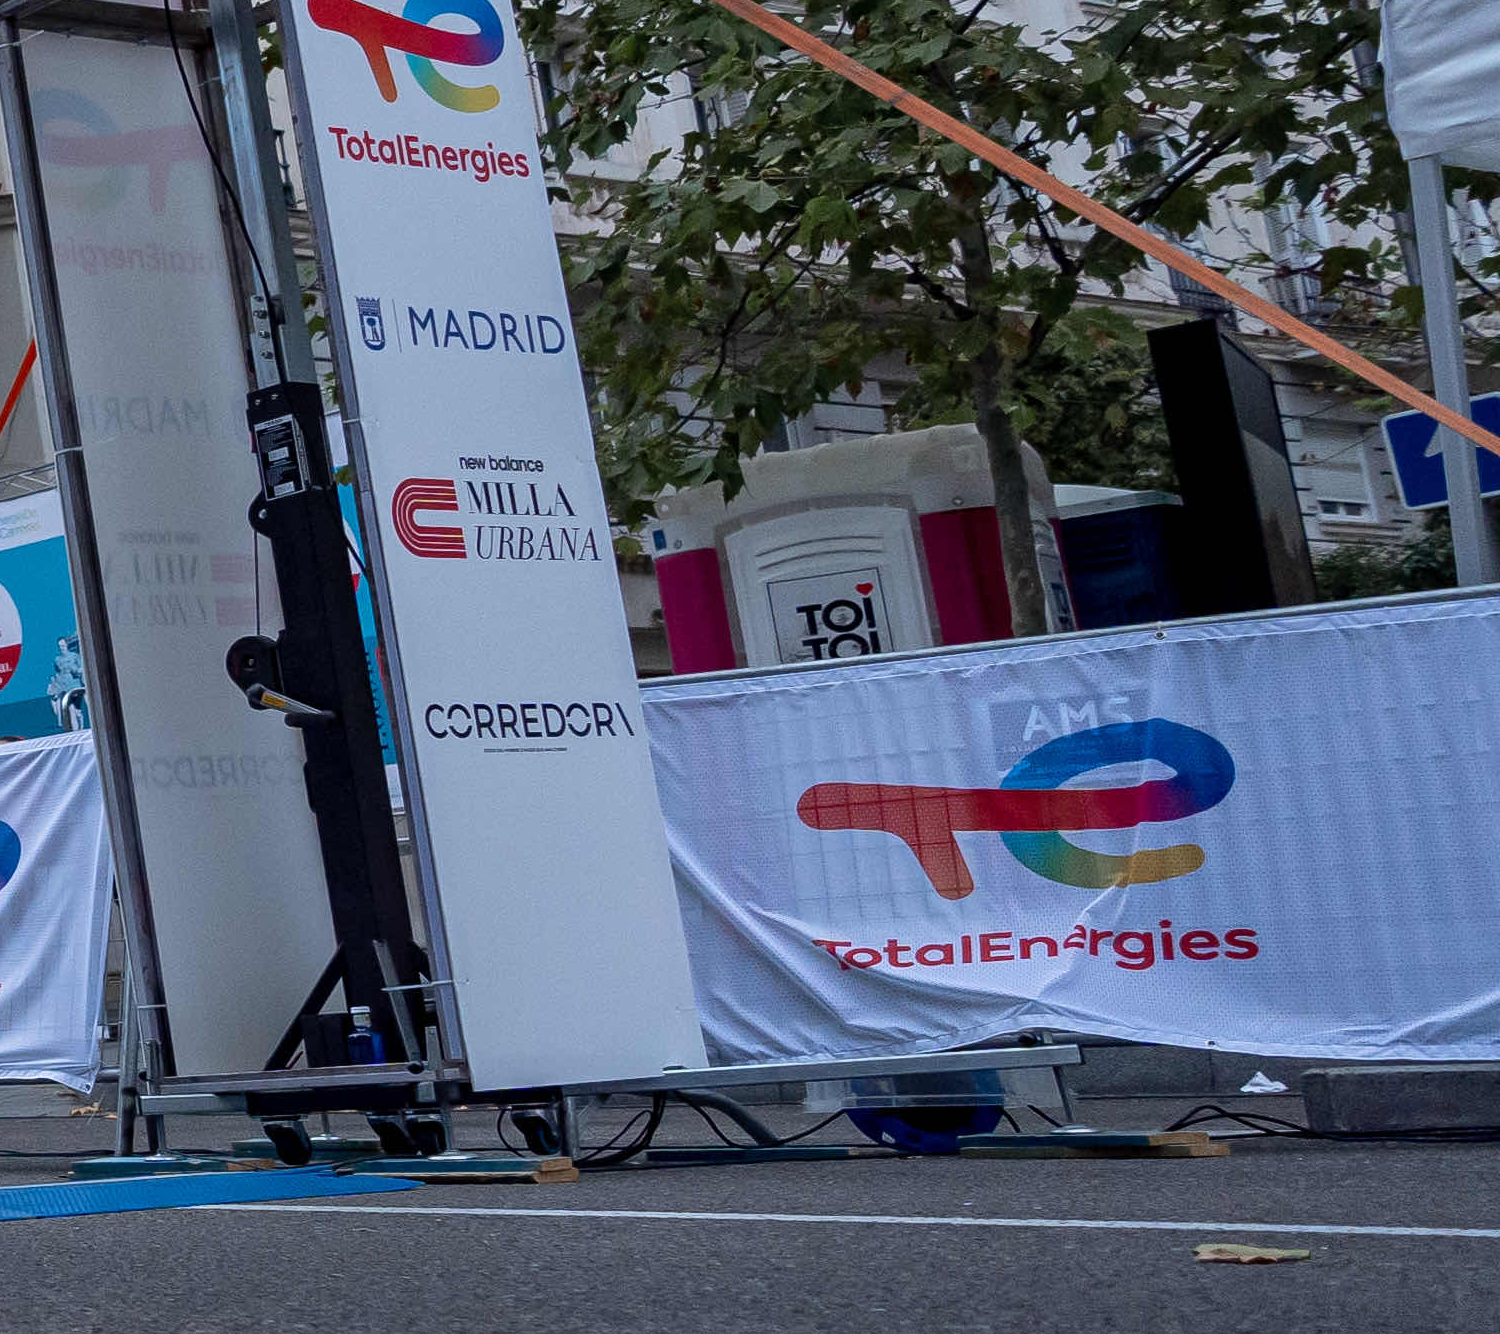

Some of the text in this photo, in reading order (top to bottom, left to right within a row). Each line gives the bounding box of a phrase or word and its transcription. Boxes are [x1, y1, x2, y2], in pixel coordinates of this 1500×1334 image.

[328, 127, 530, 183] TotalEnergies
[408, 306, 566, 354] MADRID
[459, 455, 544, 472] new balance
[463, 480, 577, 516] MILLA
[474, 525, 602, 561] URBANA
